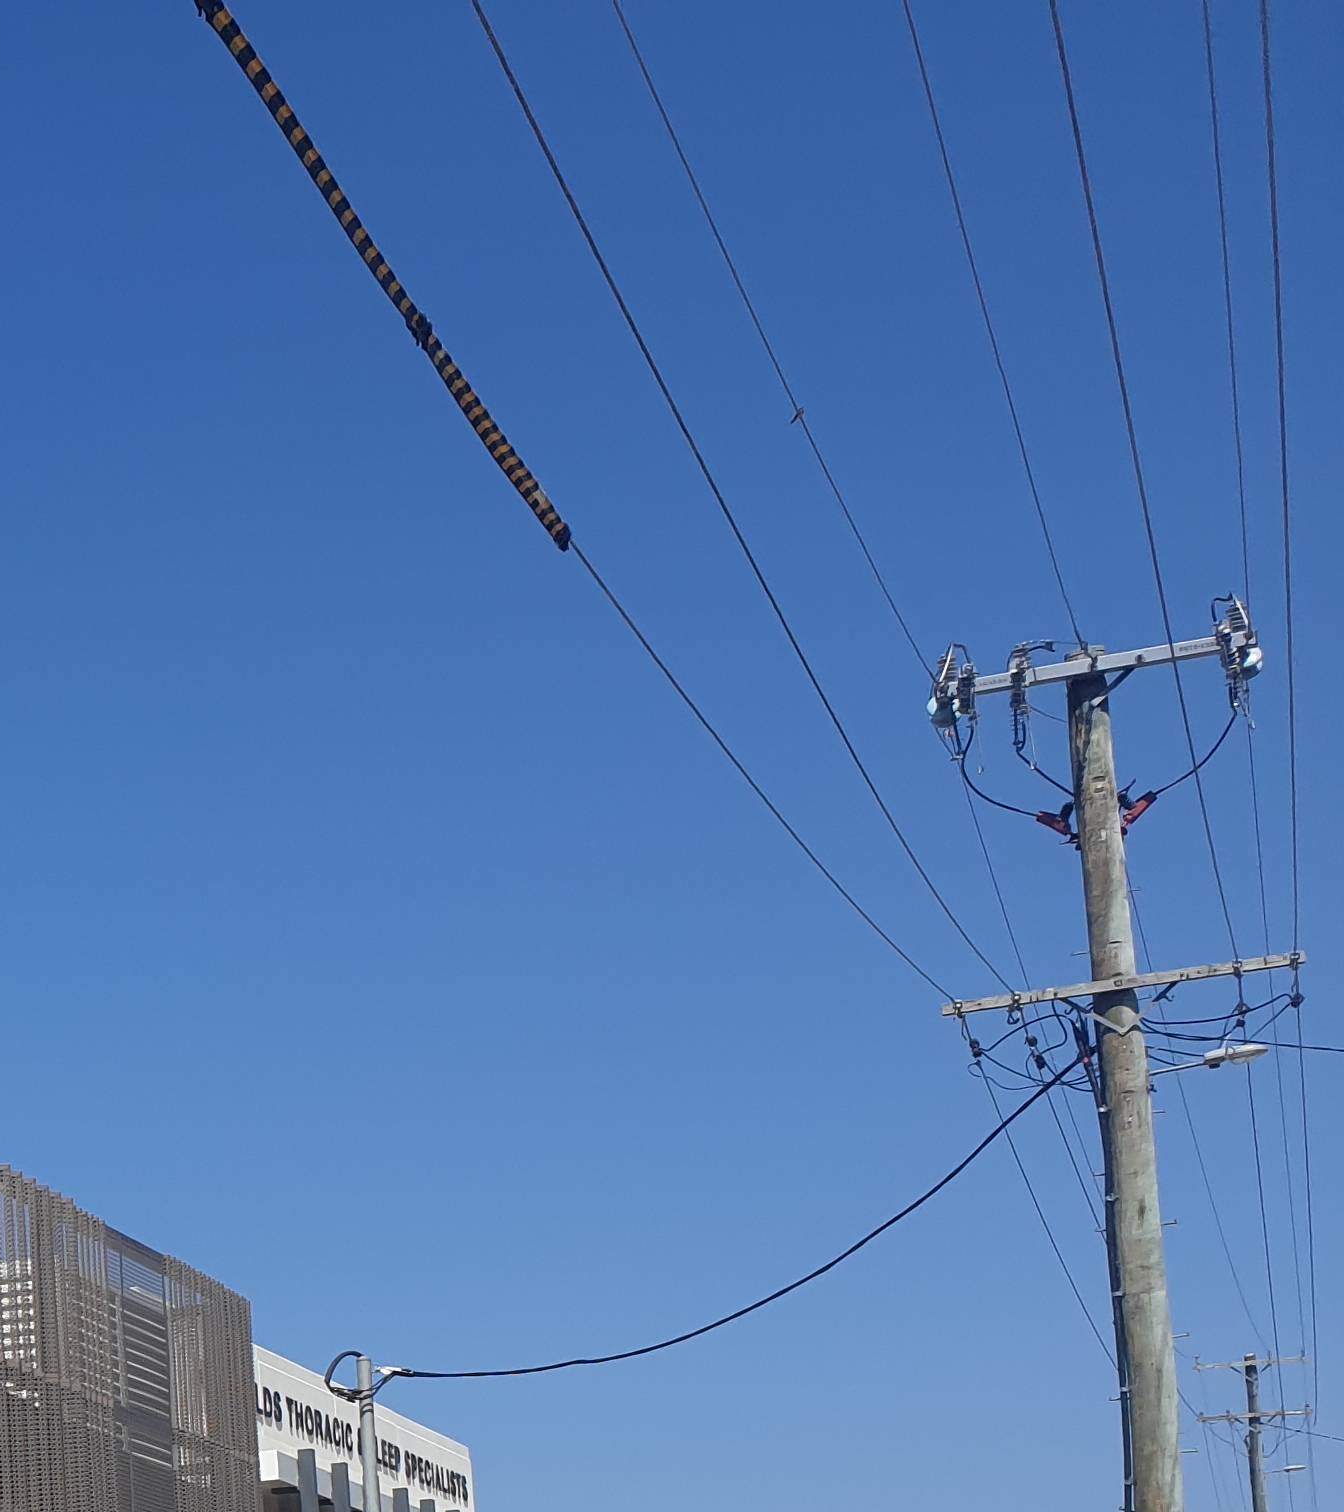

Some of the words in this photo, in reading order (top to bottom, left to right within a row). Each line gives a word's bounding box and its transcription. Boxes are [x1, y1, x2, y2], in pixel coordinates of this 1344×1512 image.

[285, 1395, 354, 1452] THORACIC
[374, 1436, 401, 1472] LEEP
[404, 1449, 469, 1502] SPECIALISTS
